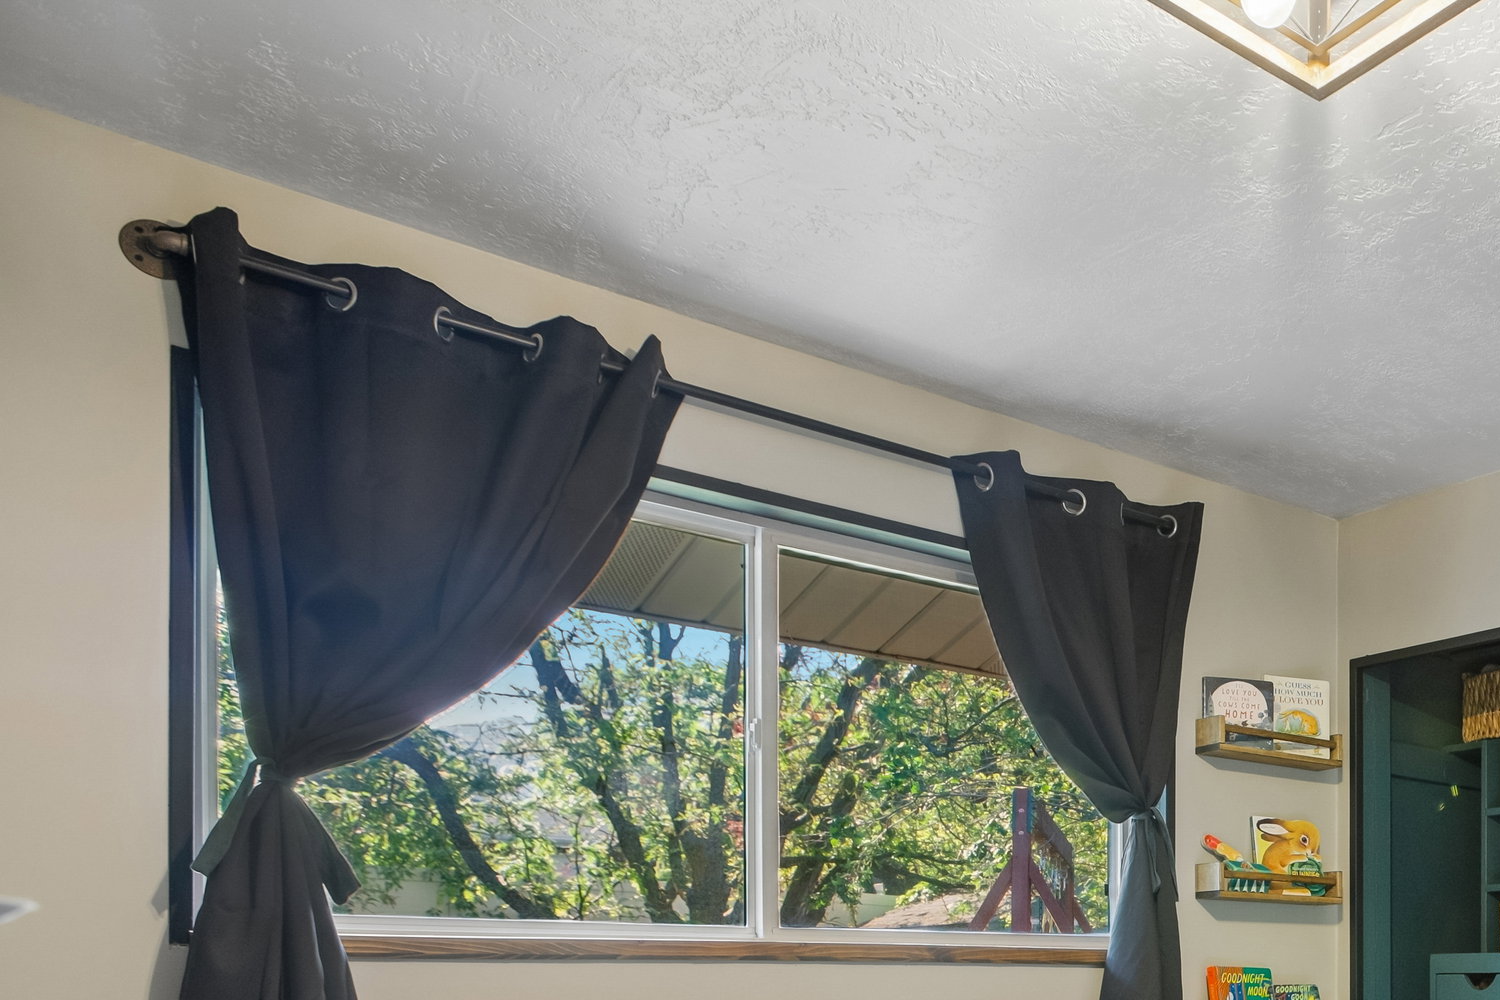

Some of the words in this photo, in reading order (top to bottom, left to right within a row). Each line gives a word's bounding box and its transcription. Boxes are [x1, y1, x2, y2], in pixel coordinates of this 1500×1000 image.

[1285, 681, 1312, 689] GUESS
[1274, 688, 1294, 696] HOW
[1297, 690, 1322, 698] MUCH
[1279, 696, 1303, 704] LOVE
[1305, 698, 1324, 706] YOU
[1225, 710, 1254, 719] HOME
[1221, 972, 1265, 984] GOODNIGHT
[1247, 987, 1270, 997] MOON
[1275, 985, 1311, 994] GOODNIGHT
